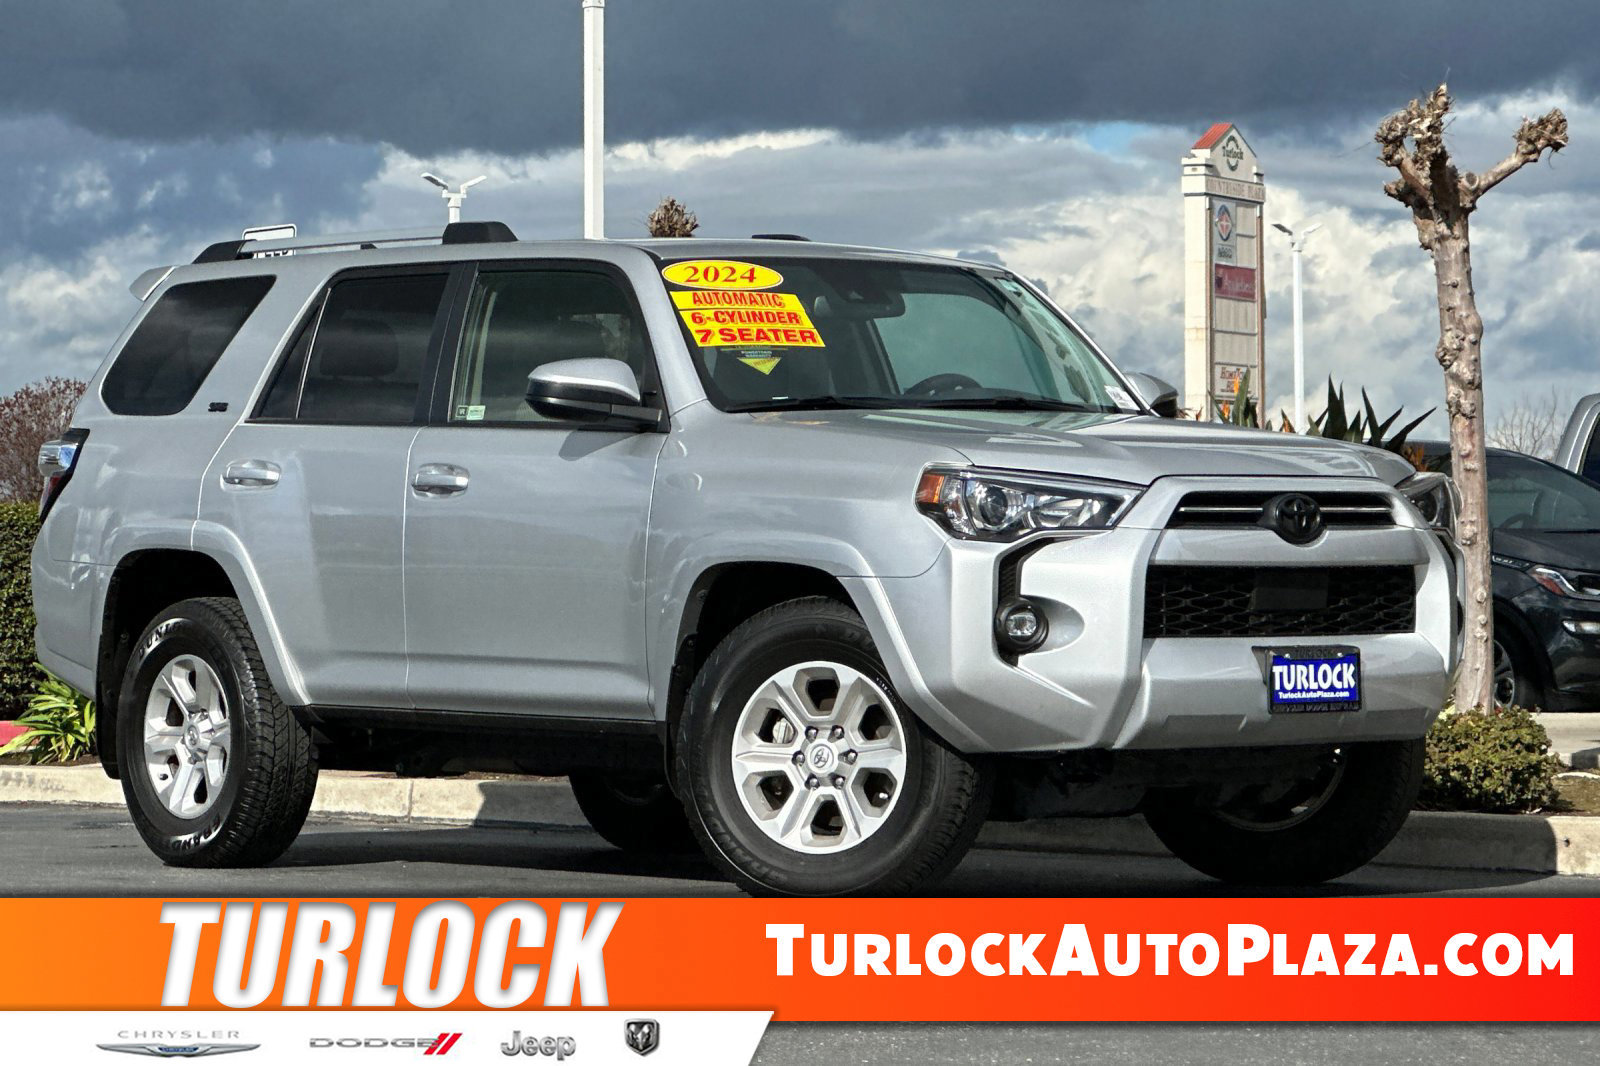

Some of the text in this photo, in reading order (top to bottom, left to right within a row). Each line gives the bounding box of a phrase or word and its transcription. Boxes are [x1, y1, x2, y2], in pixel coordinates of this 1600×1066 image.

[1222, 146, 1244, 161] Turlock
[684, 265, 757, 283] 2024
[692, 291, 786, 308] AUTOMATIC
[691, 310, 804, 326] 6-CYLINDER
[695, 328, 819, 345] 7 SEATER
[1272, 663, 1356, 691] TURLOCK
[1278, 691, 1350, 699] TurlockAutoPlaza.com
